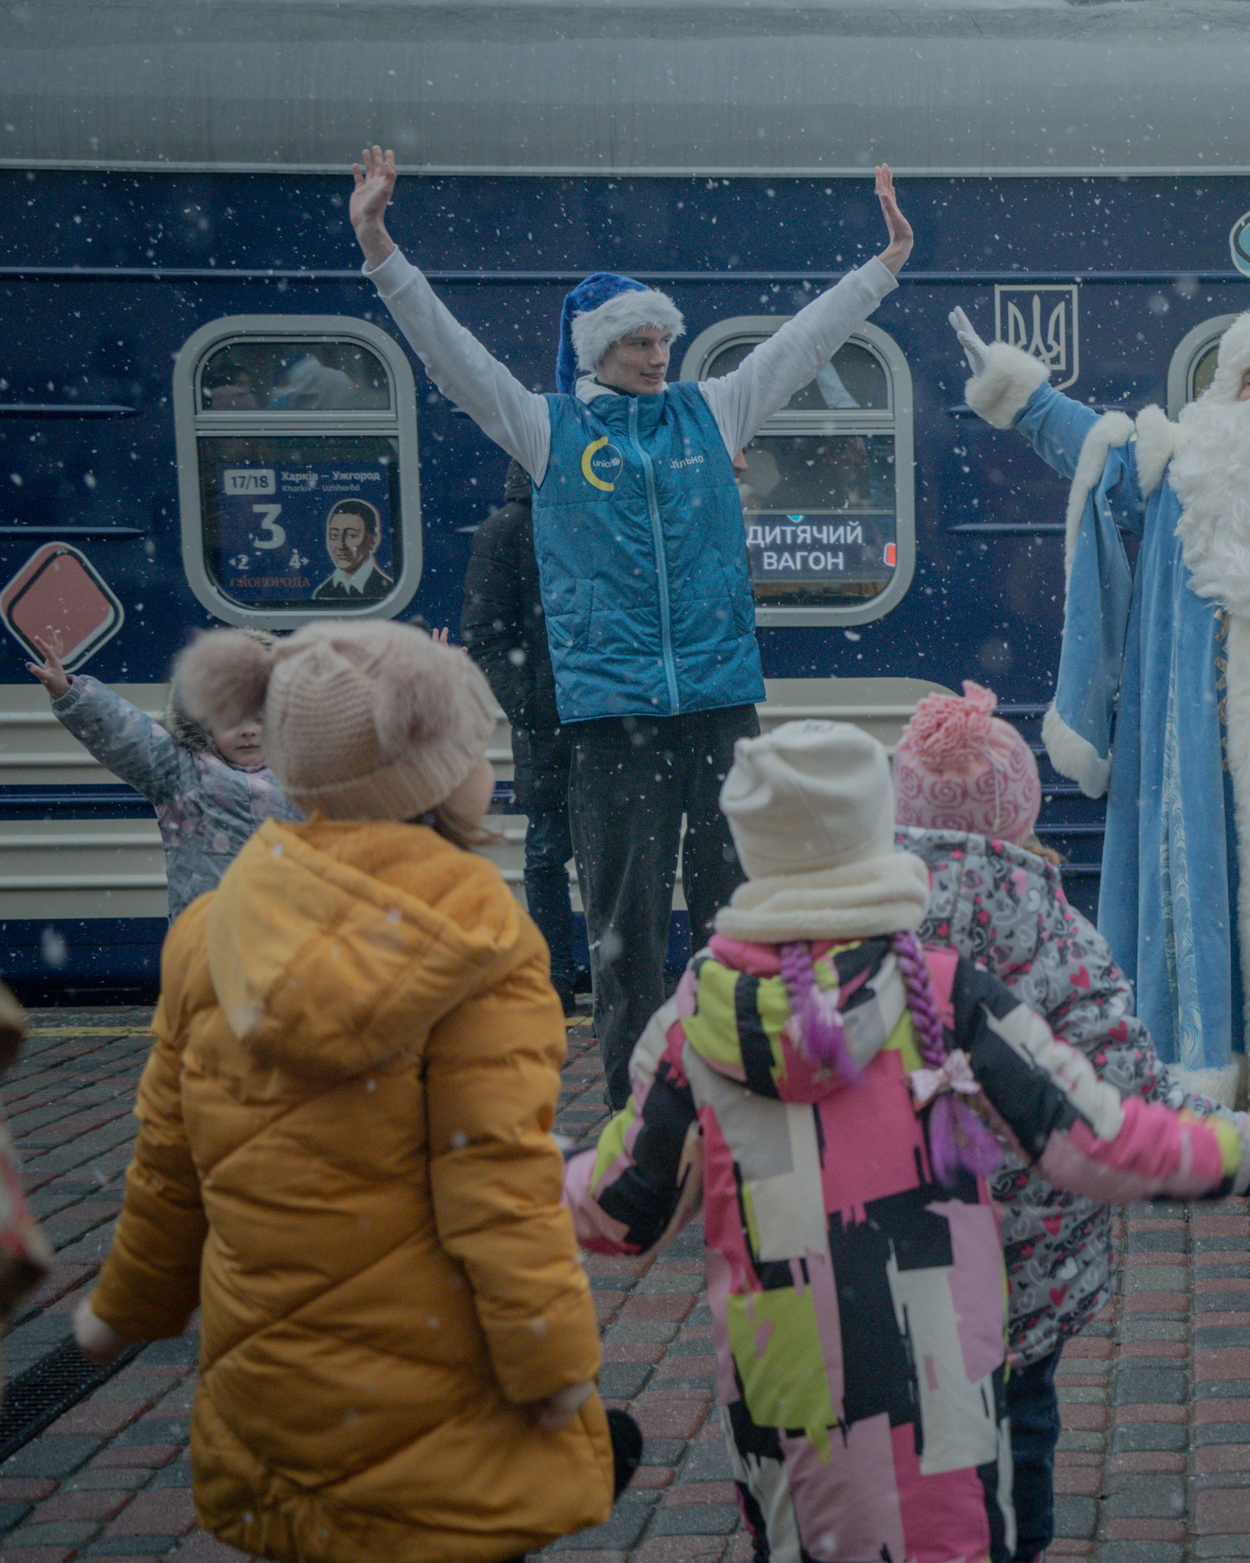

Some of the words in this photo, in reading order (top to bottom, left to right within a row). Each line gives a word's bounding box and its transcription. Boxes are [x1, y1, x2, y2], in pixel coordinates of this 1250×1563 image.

[230, 475, 269, 490] 17/18
[281, 471, 319, 483] Харків
[332, 471, 381, 482] Ужгород
[253, 504, 286, 549] 3
[746, 520, 862, 548] ДИТЯЧИЙ
[237, 554, 249, 570] 2
[289, 553, 301, 569] 4
[763, 551, 844, 570] ВАГОН
